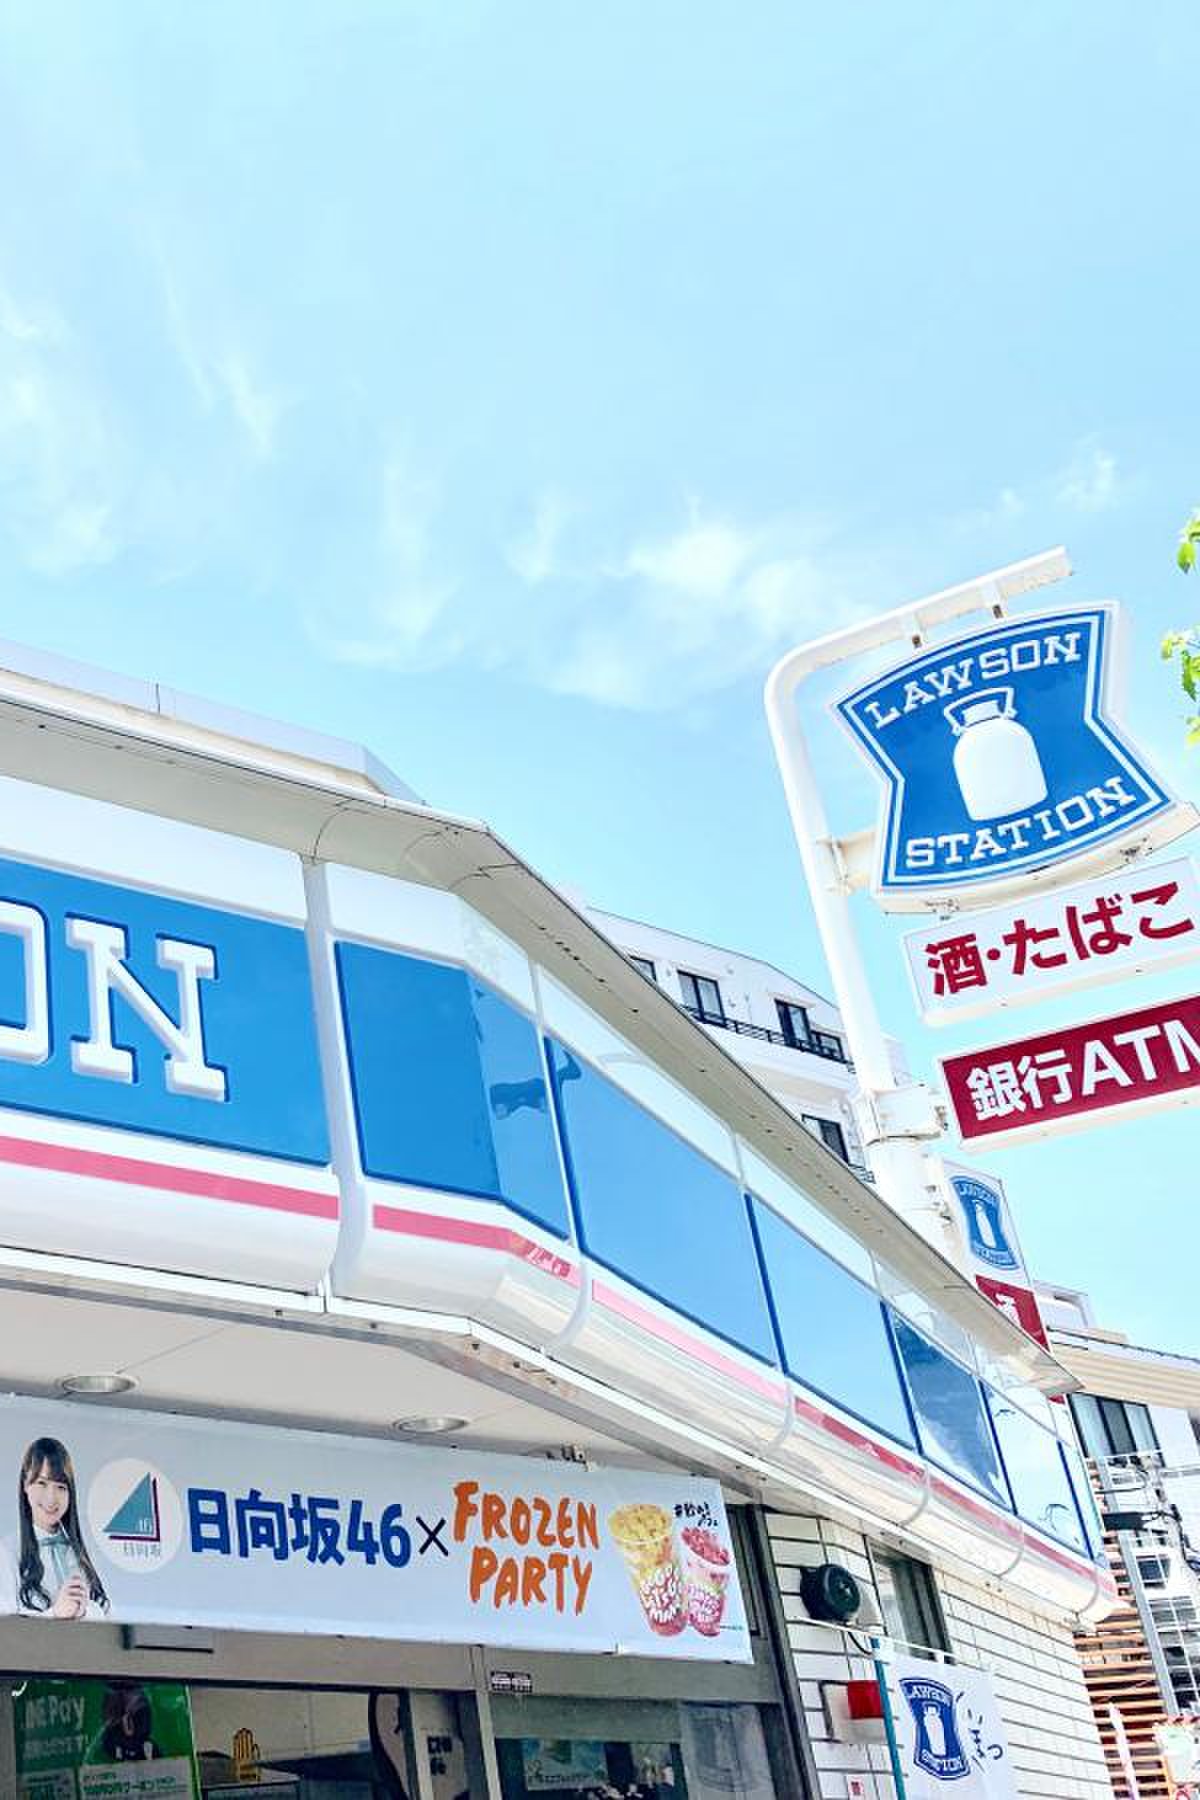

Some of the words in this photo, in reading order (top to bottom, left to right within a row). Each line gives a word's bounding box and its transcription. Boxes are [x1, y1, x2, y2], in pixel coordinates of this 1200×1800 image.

[865, 631, 1082, 730] LAWSON
[906, 776, 1136, 868] STATION
[453, 1480, 600, 1550] FROZEN
[469, 1545, 594, 1616] PARTY
